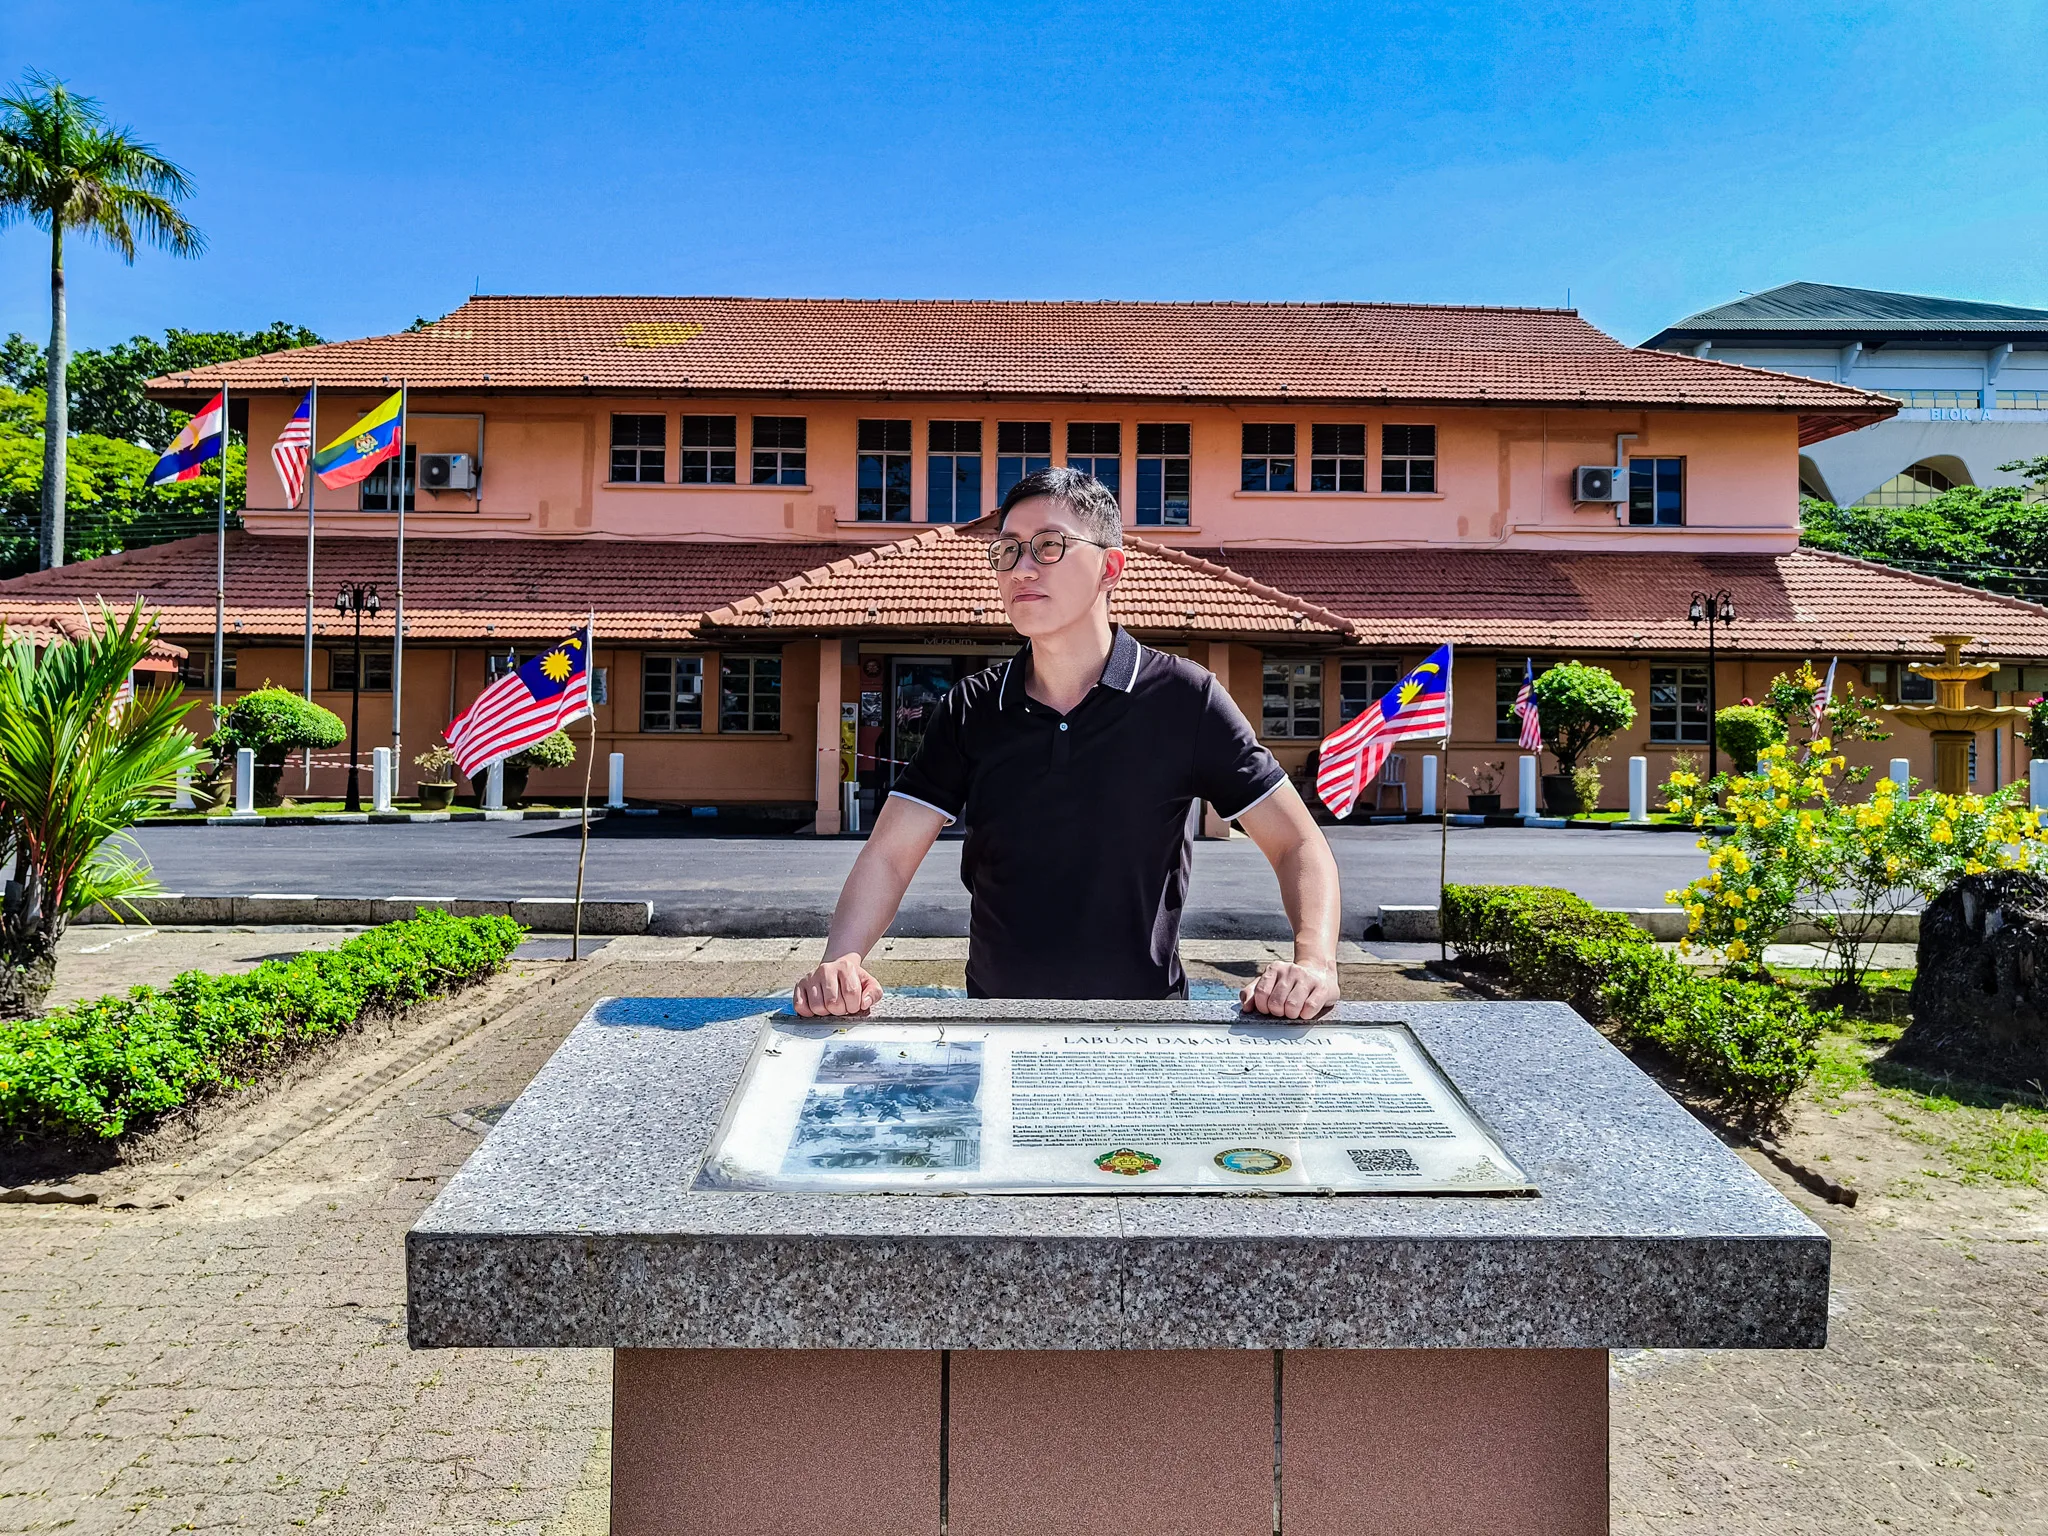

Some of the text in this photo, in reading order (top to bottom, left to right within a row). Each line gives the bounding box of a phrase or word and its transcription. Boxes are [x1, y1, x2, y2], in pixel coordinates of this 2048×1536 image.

[1930, 408, 1993, 421] BLOK A
[1157, 1037, 1230, 1045] DALAM
[1240, 1037, 1331, 1045] SEJARAH
